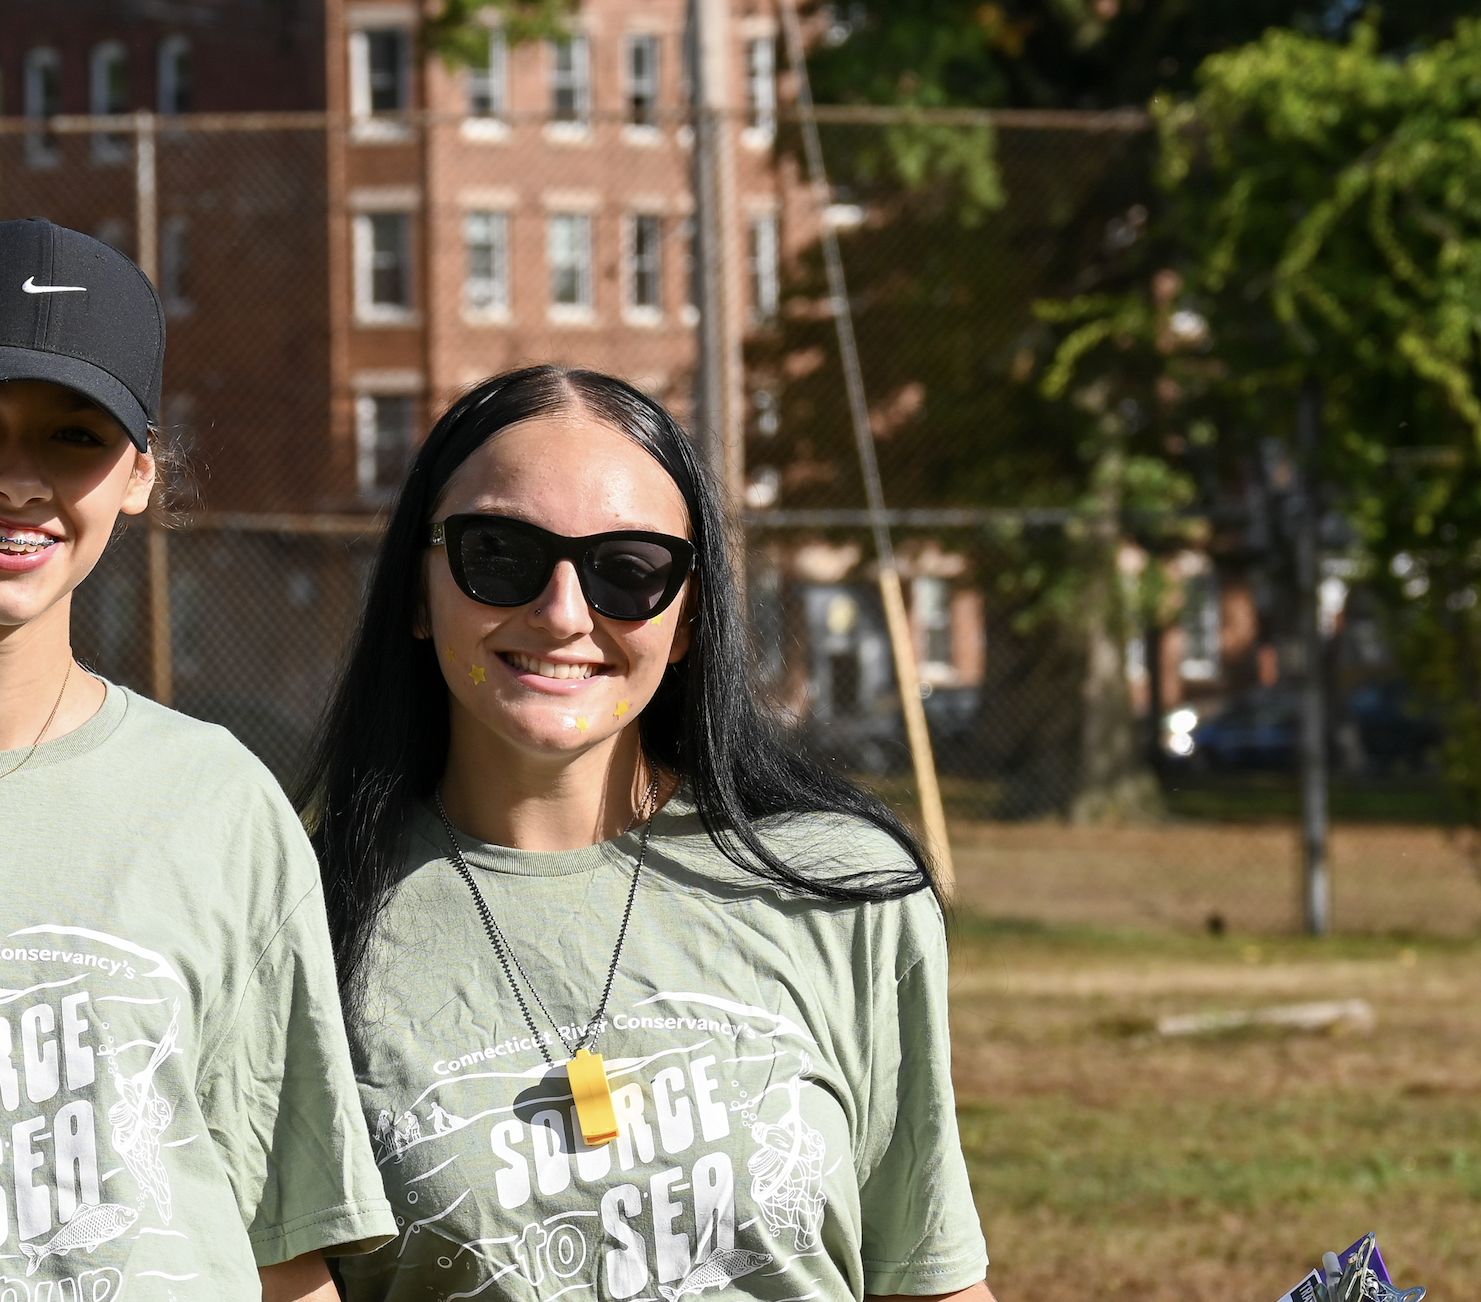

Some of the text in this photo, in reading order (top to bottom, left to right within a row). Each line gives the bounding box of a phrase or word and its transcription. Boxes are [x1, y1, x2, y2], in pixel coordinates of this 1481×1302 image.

[432, 1013, 757, 1076] Connecticut River Conservancy's
[514, 1151, 736, 1300] to SEA
